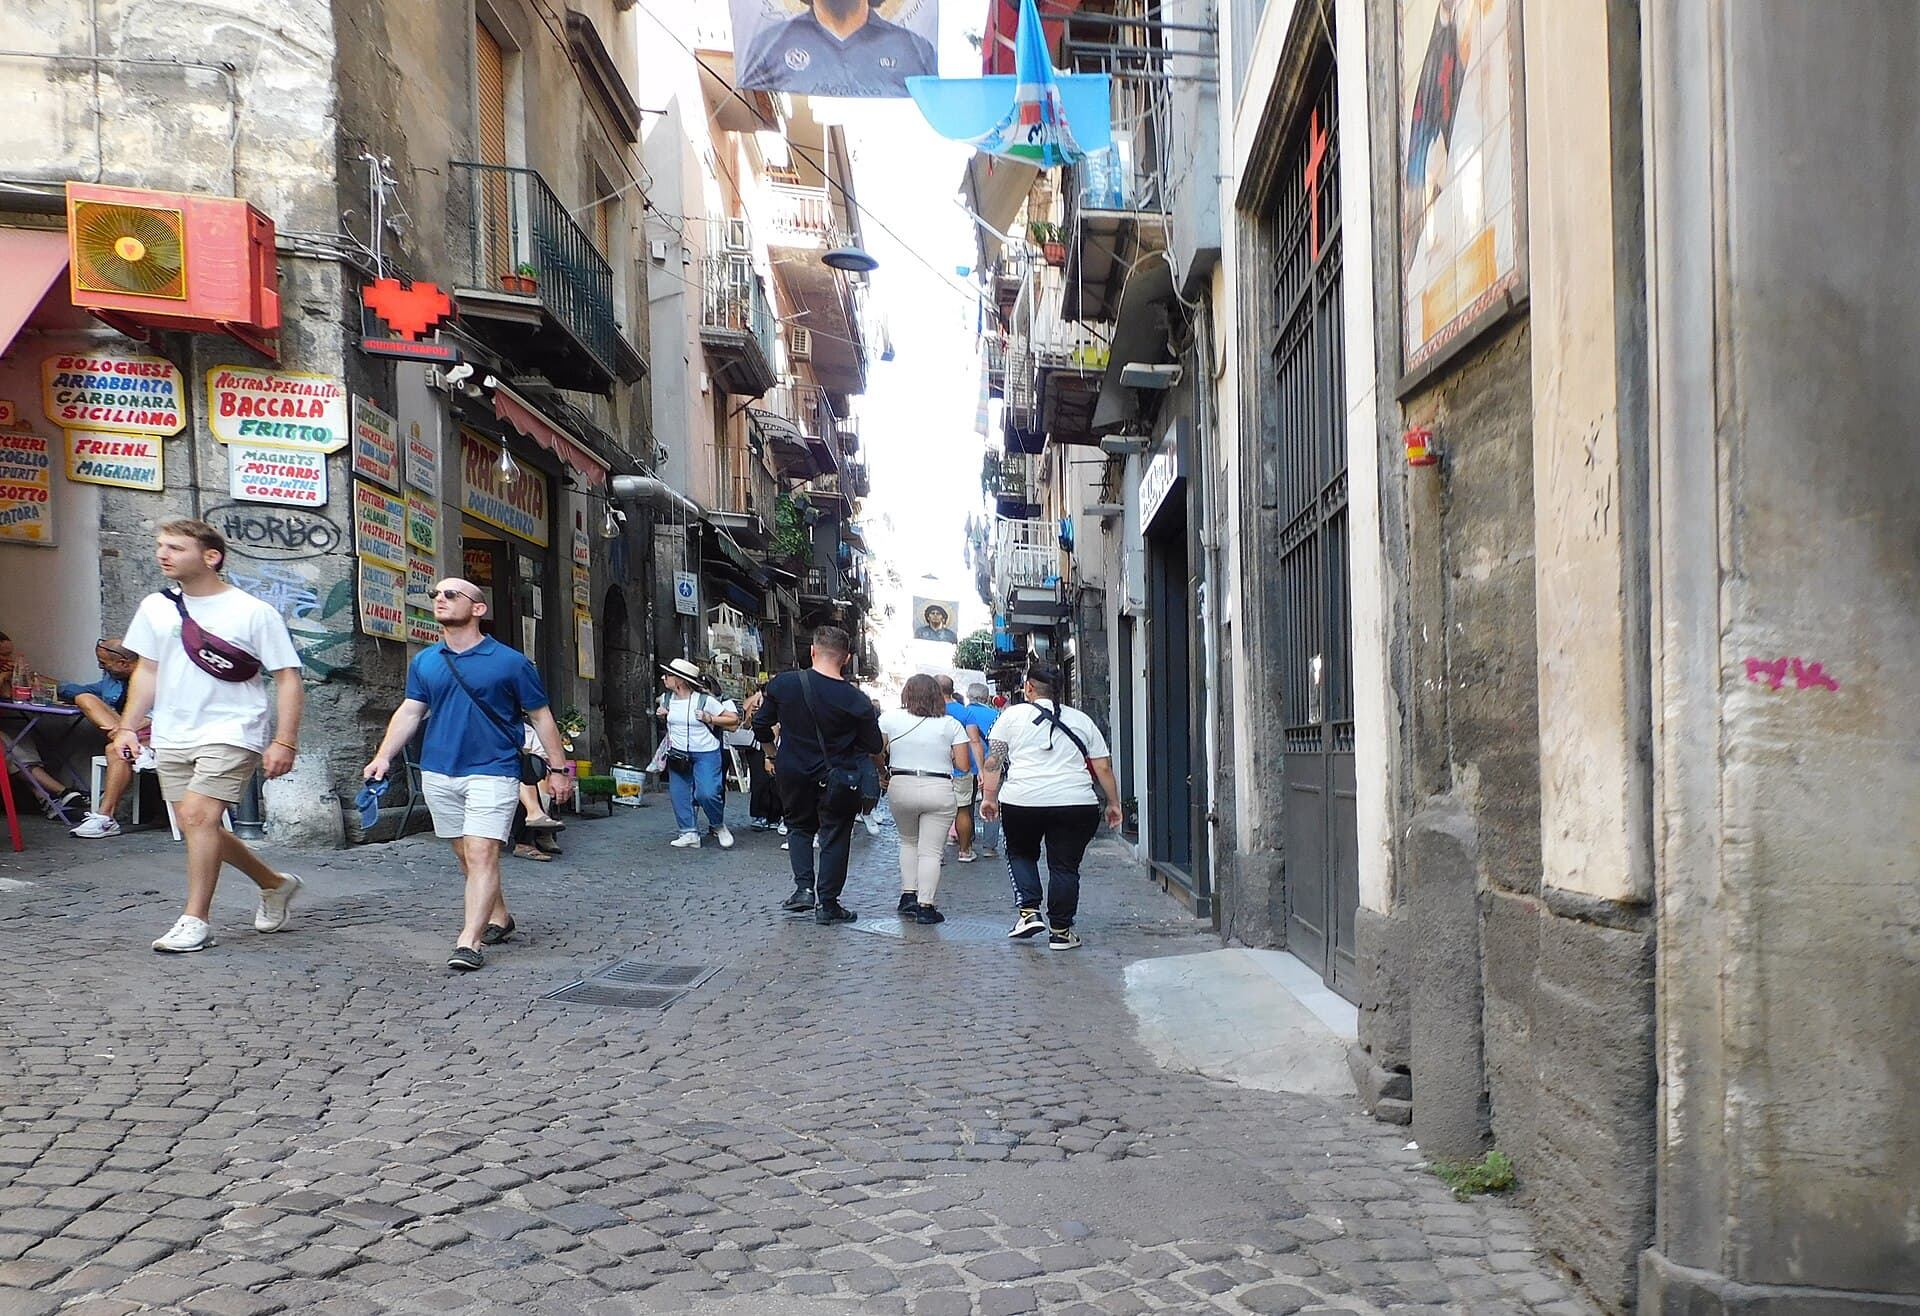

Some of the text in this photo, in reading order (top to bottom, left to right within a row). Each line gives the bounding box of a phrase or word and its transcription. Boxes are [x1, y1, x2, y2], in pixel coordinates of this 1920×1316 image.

[56, 357, 173, 378] BOLOGNESE
[52, 373, 173, 394] ARRABBIATA
[216, 372, 264, 391] NOSTRA
[56, 391, 176, 409] CARBONARA
[61, 405, 177, 427] SICILIANA
[238, 420, 333, 444] FRITTO
[242, 451, 315, 466] MAGNETS
[241, 475, 278, 486] SHOP
[245, 463, 320, 481] POSTCARDS
[246, 485, 317, 501] CORNER
[366, 602, 402, 624] LINGUINE
[411, 628, 440, 642] ARMENO
